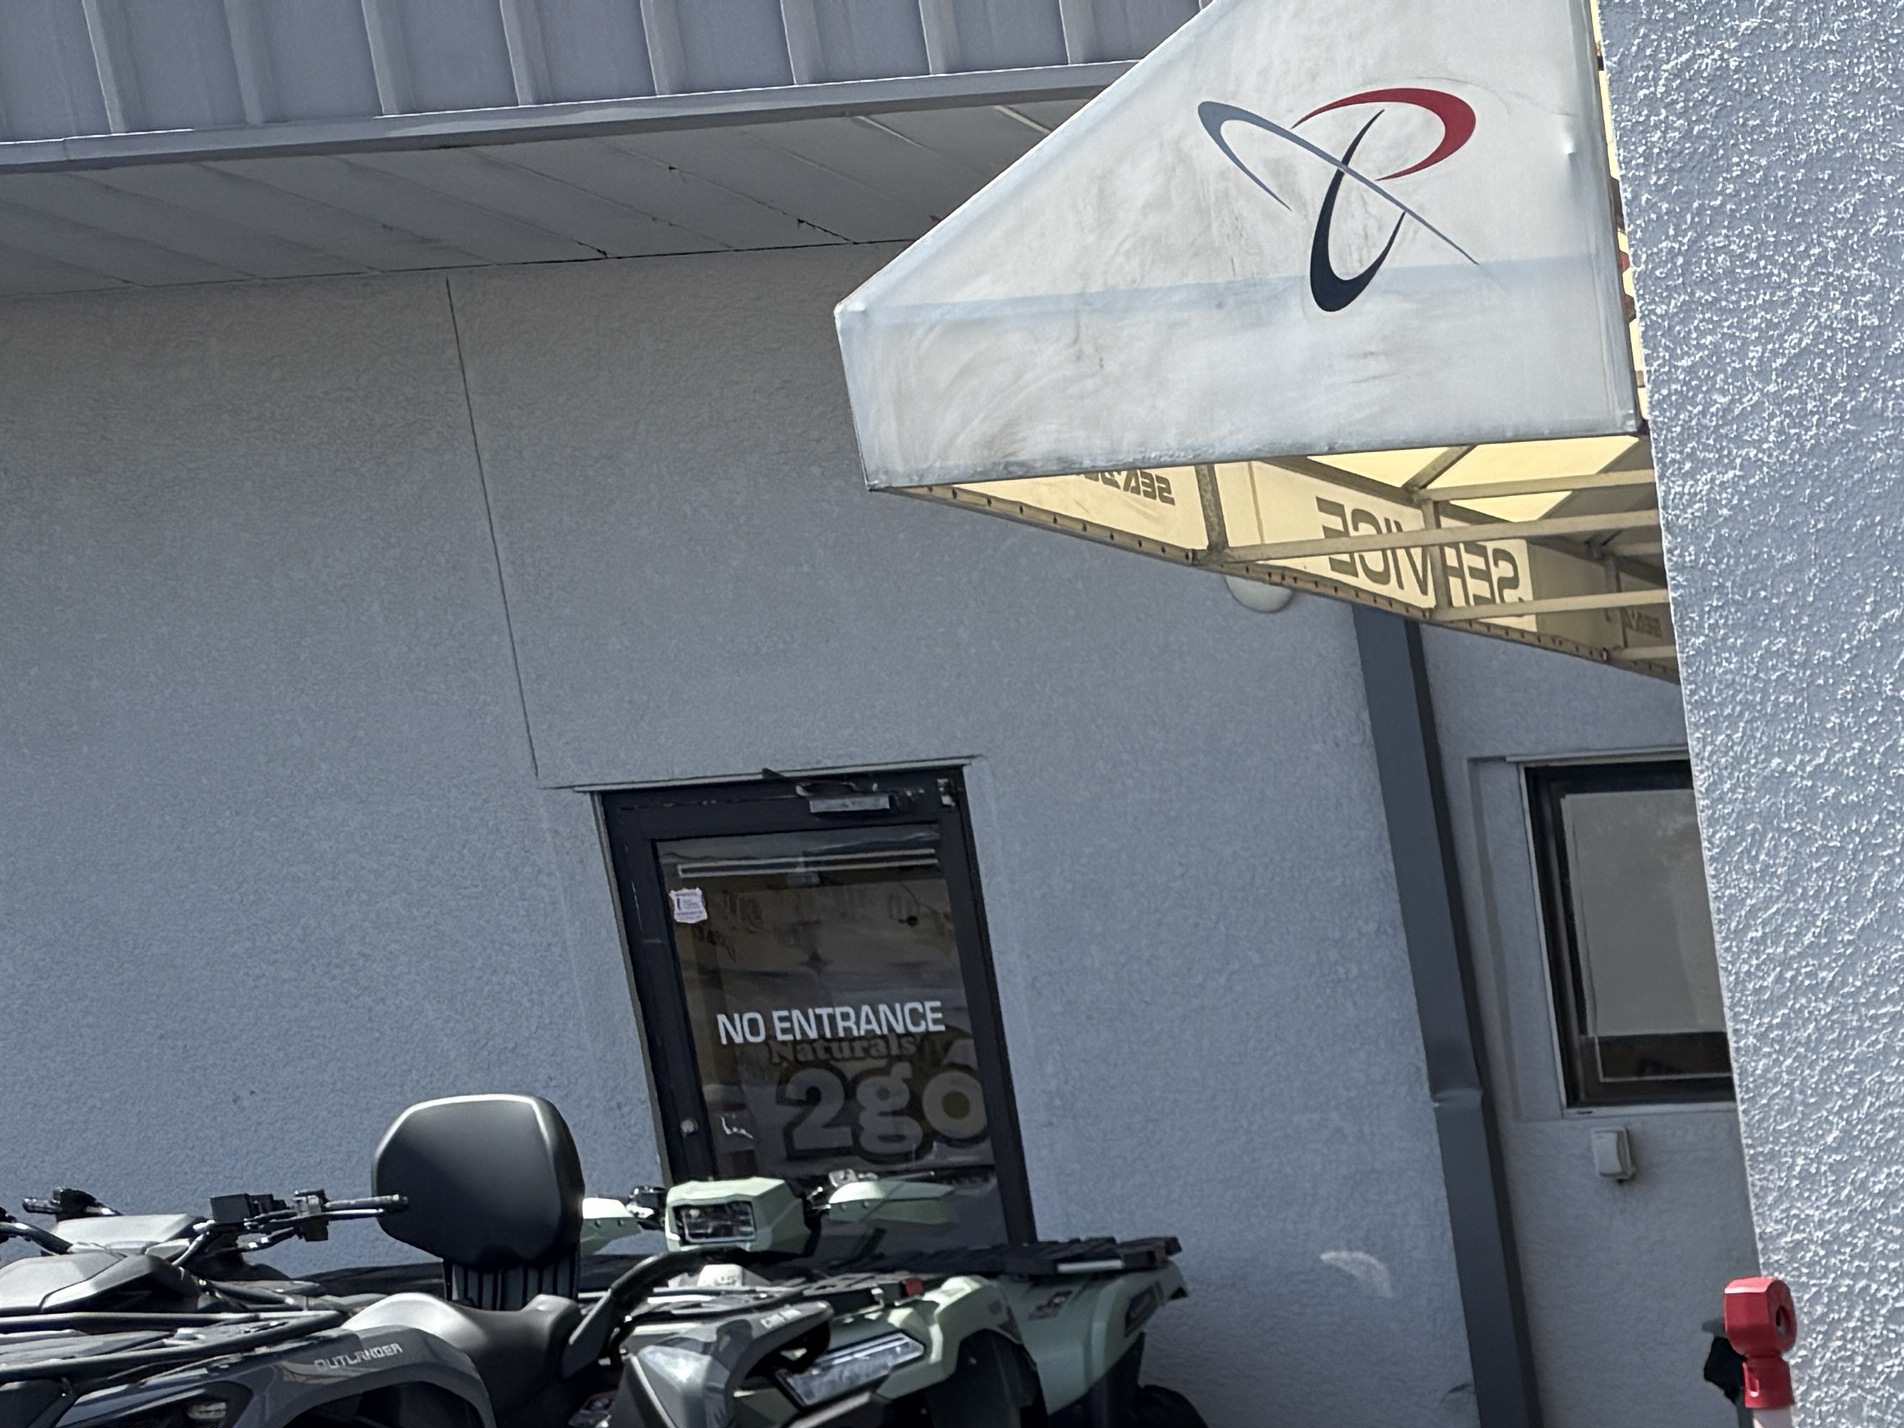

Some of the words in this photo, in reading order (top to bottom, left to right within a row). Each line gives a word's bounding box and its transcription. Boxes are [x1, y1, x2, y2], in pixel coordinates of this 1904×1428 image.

[717, 1012, 766, 1045] NO
[772, 1001, 946, 1041] ENTRANCE
[314, 1343, 404, 1371] OUTLANDER
